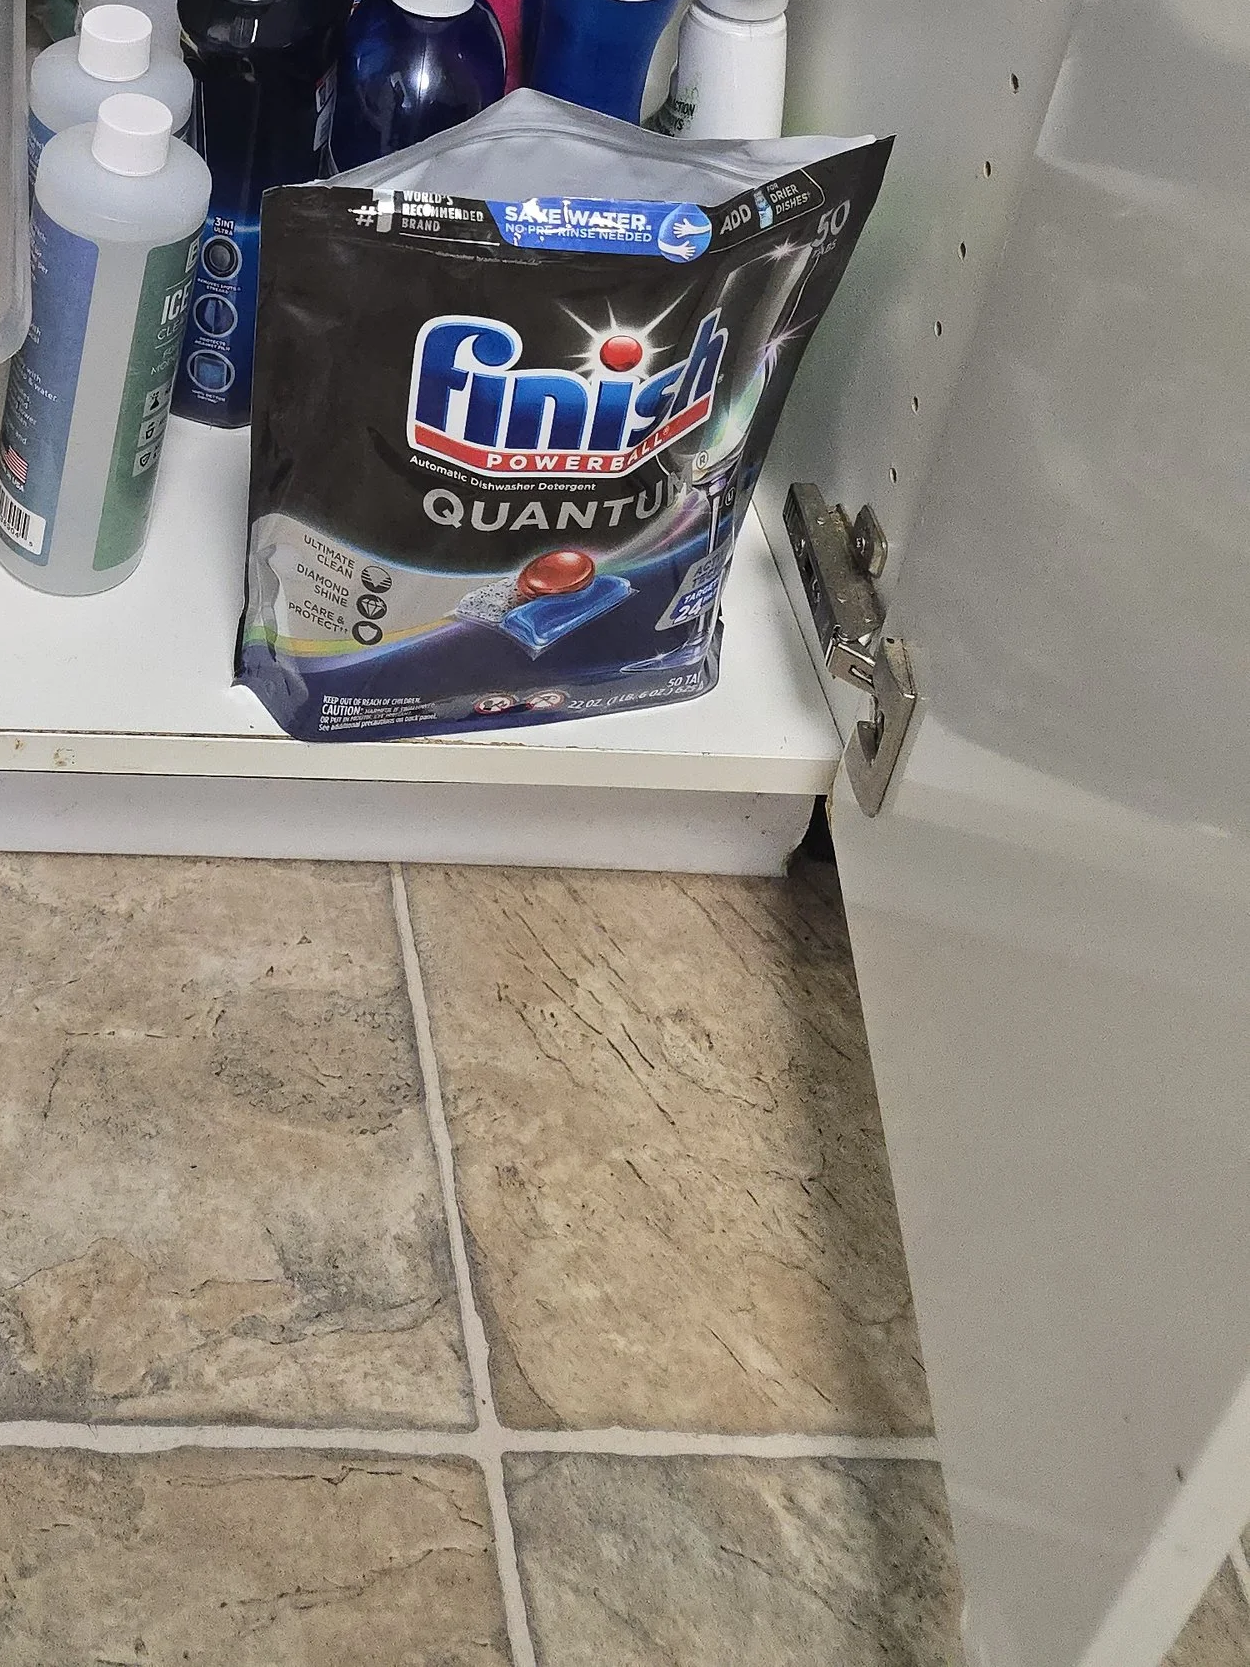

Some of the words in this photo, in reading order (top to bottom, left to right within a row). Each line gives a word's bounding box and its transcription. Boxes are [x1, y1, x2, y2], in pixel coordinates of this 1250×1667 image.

[403, 190, 454, 206] WORLD'S
[769, 184, 799, 204] DRIER
[402, 203, 484, 222] RECOMMENDED
[505, 206, 561, 224] SAVE
[719, 203, 752, 236] ADD
[810, 199, 851, 248] 50
[213, 226, 233, 236] ULTRA
[402, 217, 441, 232] BRAND
[505, 223, 525, 234] NO
[599, 230, 653, 243] NEEDED
[161, 282, 192, 326] ICE
[413, 307, 727, 451] finish
[486, 433, 664, 472] POWERBALL
[410, 455, 468, 482] Automatic
[470, 476, 536, 492] Dishwasher
[538, 482, 597, 493] Detergent
[422, 470, 692, 531] QUANTUM
[303, 534, 356, 570] ULTIMATE
[316, 554, 353, 580] CLEAN
[296, 563, 350, 597] DIAMOND
[313, 584, 348, 608] SHINE
[303, 600, 335, 621] CARE
[336, 615, 345, 625] &
[673, 597, 703, 624] 24
[668, 677, 683, 688] 50
[321, 703, 364, 716] CAUTION:
[322, 694, 339, 705] KEEP
[339, 697, 353, 706] OUT
[352, 698, 362, 706] OF
[362, 697, 382, 706] REACH
[382, 698, 390, 706] OF
[568, 700, 586, 709] 22
[318, 723, 330, 732] See
[330, 721, 361, 731] additional
[361, 718, 395, 729] precautions
[404, 714, 419, 722] back
[418, 713, 438, 723] panel.
[319, 715, 330, 724] OR
[330, 715, 343, 724] PUT
[342, 715, 350, 723] IN
